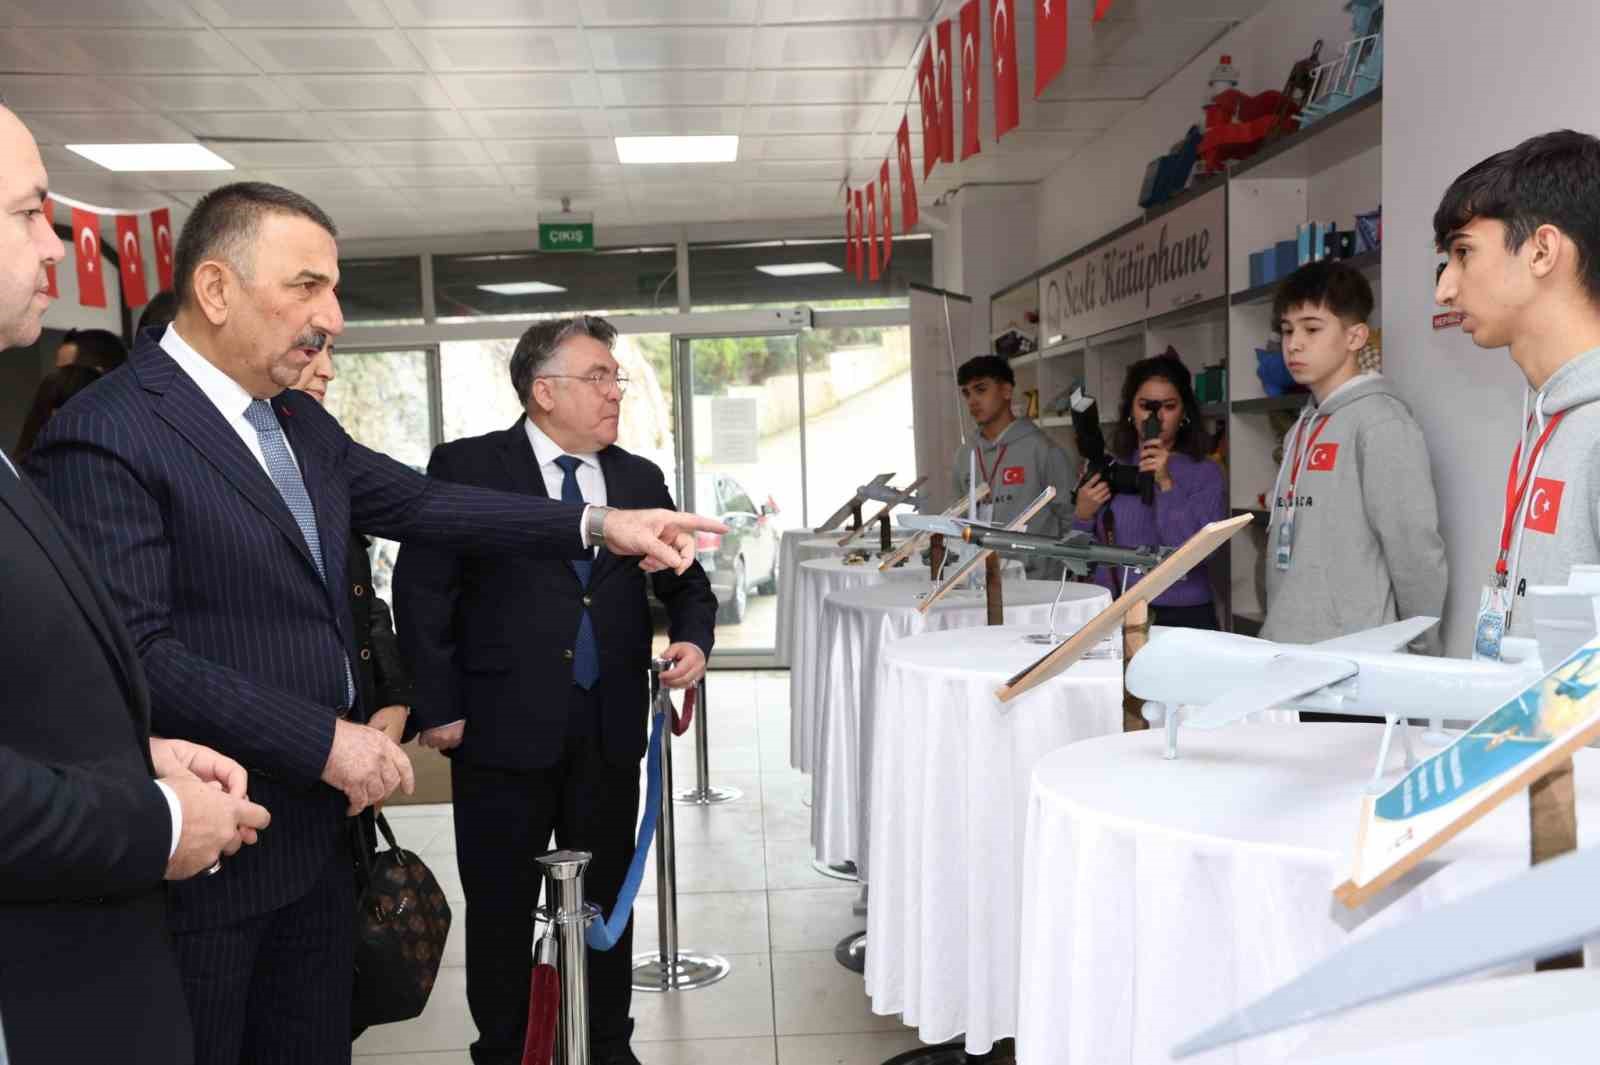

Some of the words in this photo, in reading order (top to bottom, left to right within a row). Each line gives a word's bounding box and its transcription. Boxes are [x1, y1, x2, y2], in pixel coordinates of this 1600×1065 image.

[550, 230, 584, 244] ÇIKIŞ
[1064, 263, 1096, 319] Sesli
[1100, 224, 1211, 309] Kütüphane
